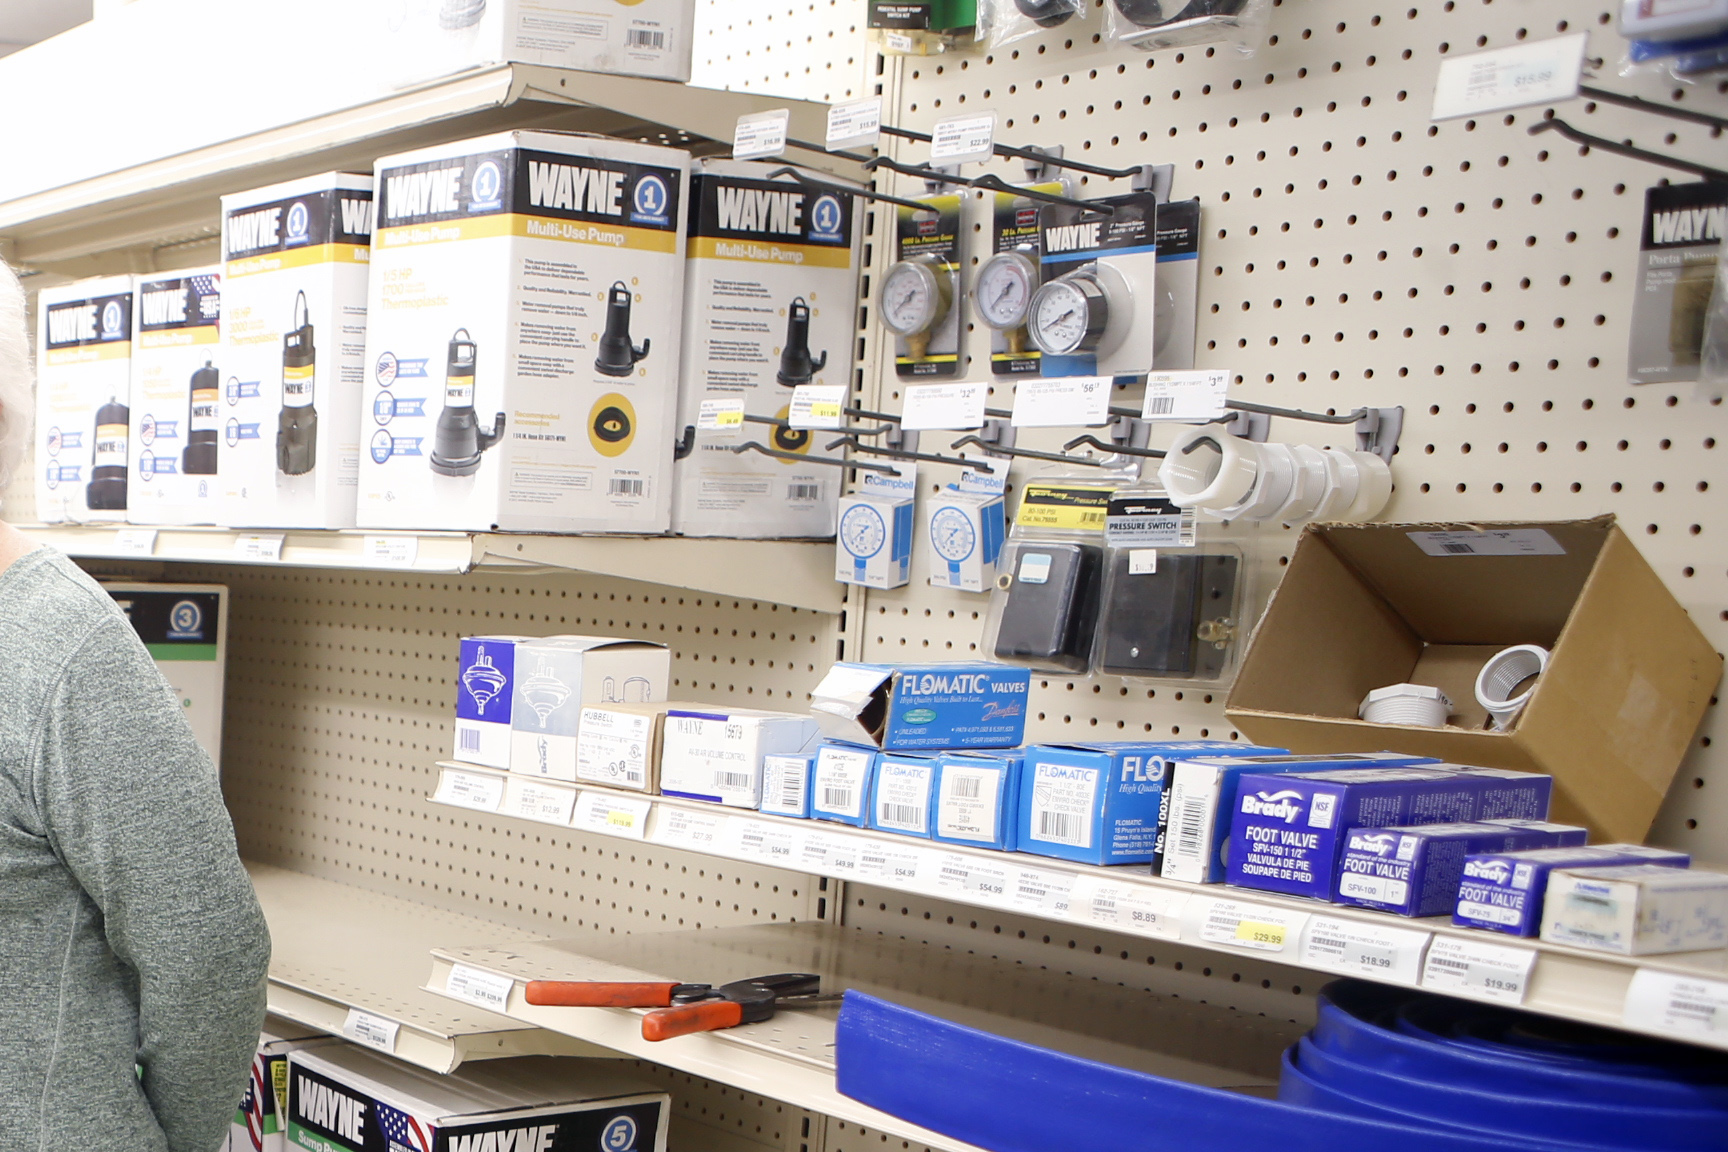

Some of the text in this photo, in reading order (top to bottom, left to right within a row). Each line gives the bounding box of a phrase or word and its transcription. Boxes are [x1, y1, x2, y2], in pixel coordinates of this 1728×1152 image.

[387, 168, 462, 219] WAYNE
[528, 160, 624, 216] WAYNE
[717, 186, 804, 236] WAYNE
[228, 207, 283, 254] WAYNE
[527, 220, 624, 247] Multi-Use Pump
[1653, 205, 1728, 244] WAYN
[1046, 222, 1101, 253] WAYNE
[716, 242, 804, 265] Multi-Use Pump
[142, 288, 188, 326] WAYNE
[48, 305, 98, 344] WAYNE
[872, 475, 913, 490] Campbell
[968, 472, 1004, 490] Campbell
[1109, 521, 1177, 531] PRESSURE SWITCH
[902, 674, 1025, 695] FLOMATIC VALVES
[584, 711, 614, 723] HUBBELL
[677, 720, 703, 736] WAYNE
[885, 766, 925, 779] FLOMATIC
[1039, 765, 1093, 782] FLOMATIC
[1119, 784, 1137, 793] High
[1241, 794, 1300, 823] Brady
[1154, 788, 1171, 854] No. 100XL
[1246, 826, 1318, 849] FOOT VALVE
[1349, 836, 1391, 856] Brady
[1253, 842, 1283, 856] SFV-150
[835, 859, 854, 869] $49.99
[1247, 853, 1309, 871] VALVULA DE PIE
[1344, 859, 1410, 880] FOOT VALVE
[894, 868, 915, 878] $54.99
[1242, 863, 1312, 883] SOUPAPE DE PIED
[1463, 862, 1508, 884] Brady
[979, 883, 1003, 894] $54.99
[1348, 883, 1376, 895] SFV-100
[1459, 887, 1524, 909] FOOT VALVE
[1132, 911, 1156, 923] $8.89
[1253, 932, 1282, 944] $29.99
[1360, 955, 1391, 968] $18.99
[1484, 978, 1518, 992] $19.99
[297, 1074, 367, 1145] WAYNE
